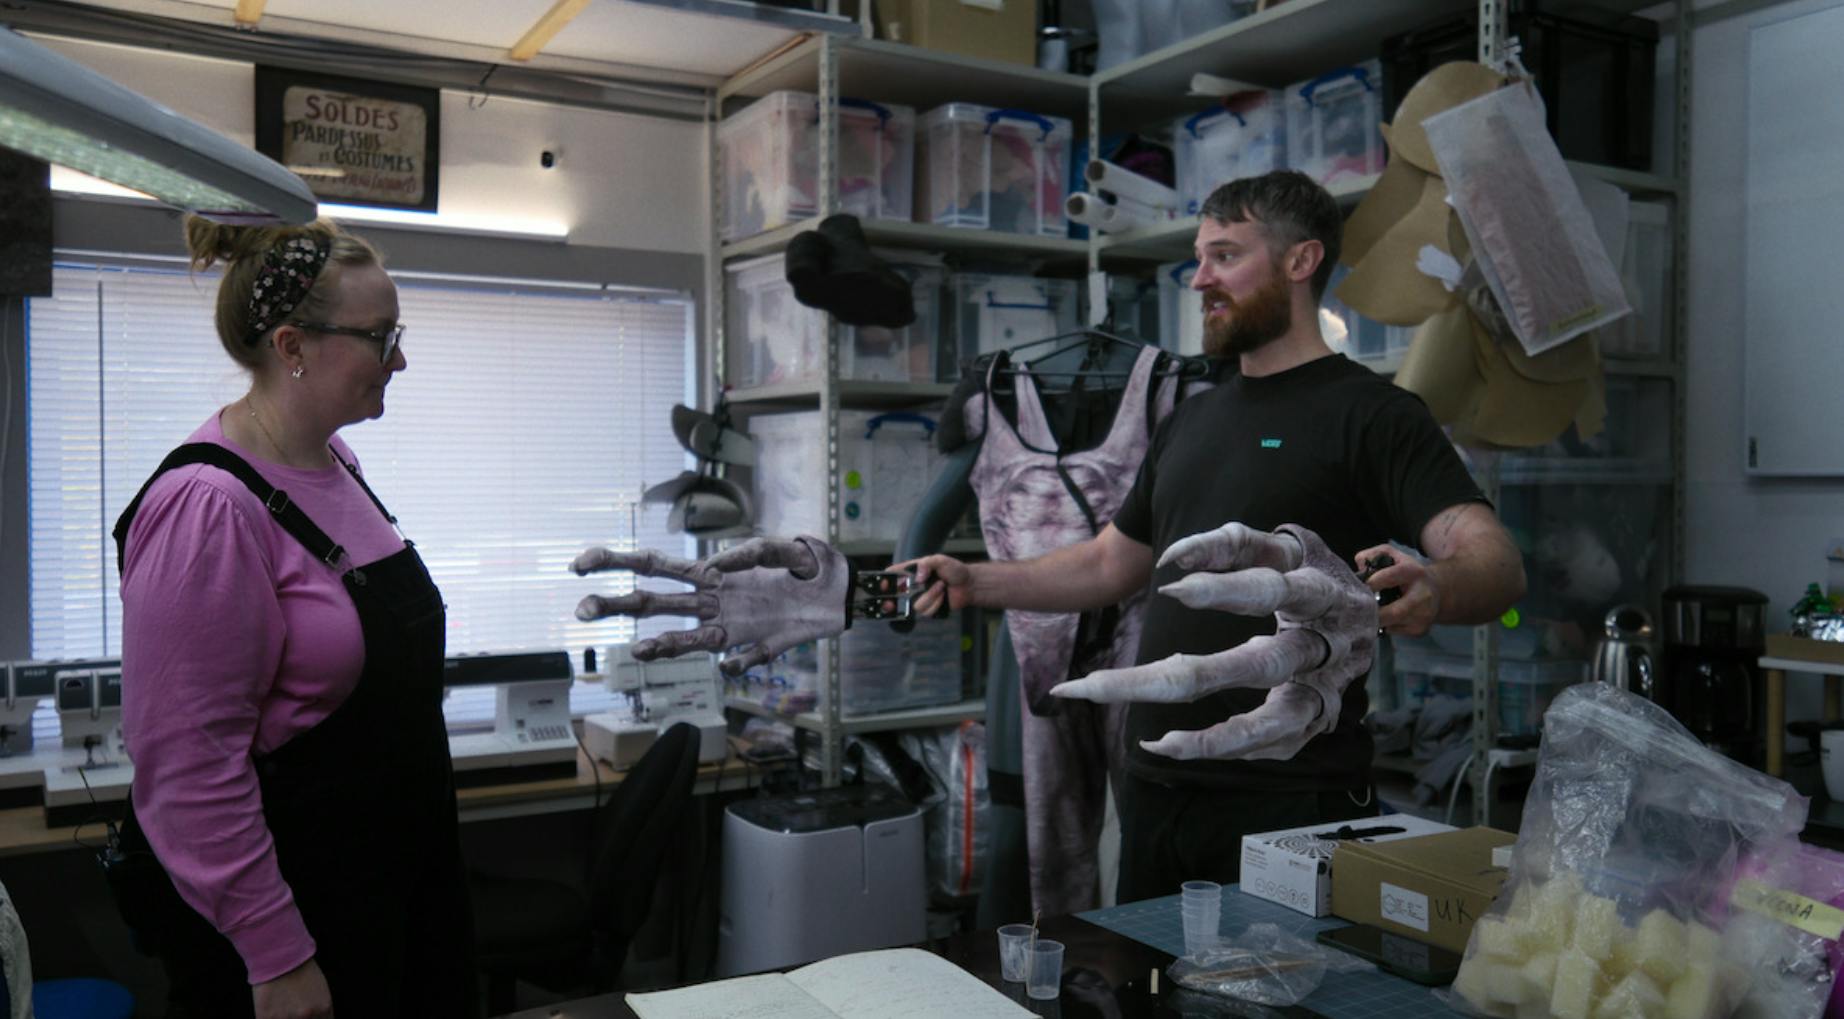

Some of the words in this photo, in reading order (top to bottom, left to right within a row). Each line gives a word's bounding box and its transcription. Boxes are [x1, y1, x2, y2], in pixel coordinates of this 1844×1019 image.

[306, 95, 398, 131] SOLDES
[292, 121, 381, 149] PARDESSUS
[334, 147, 415, 172] COSTUMES
